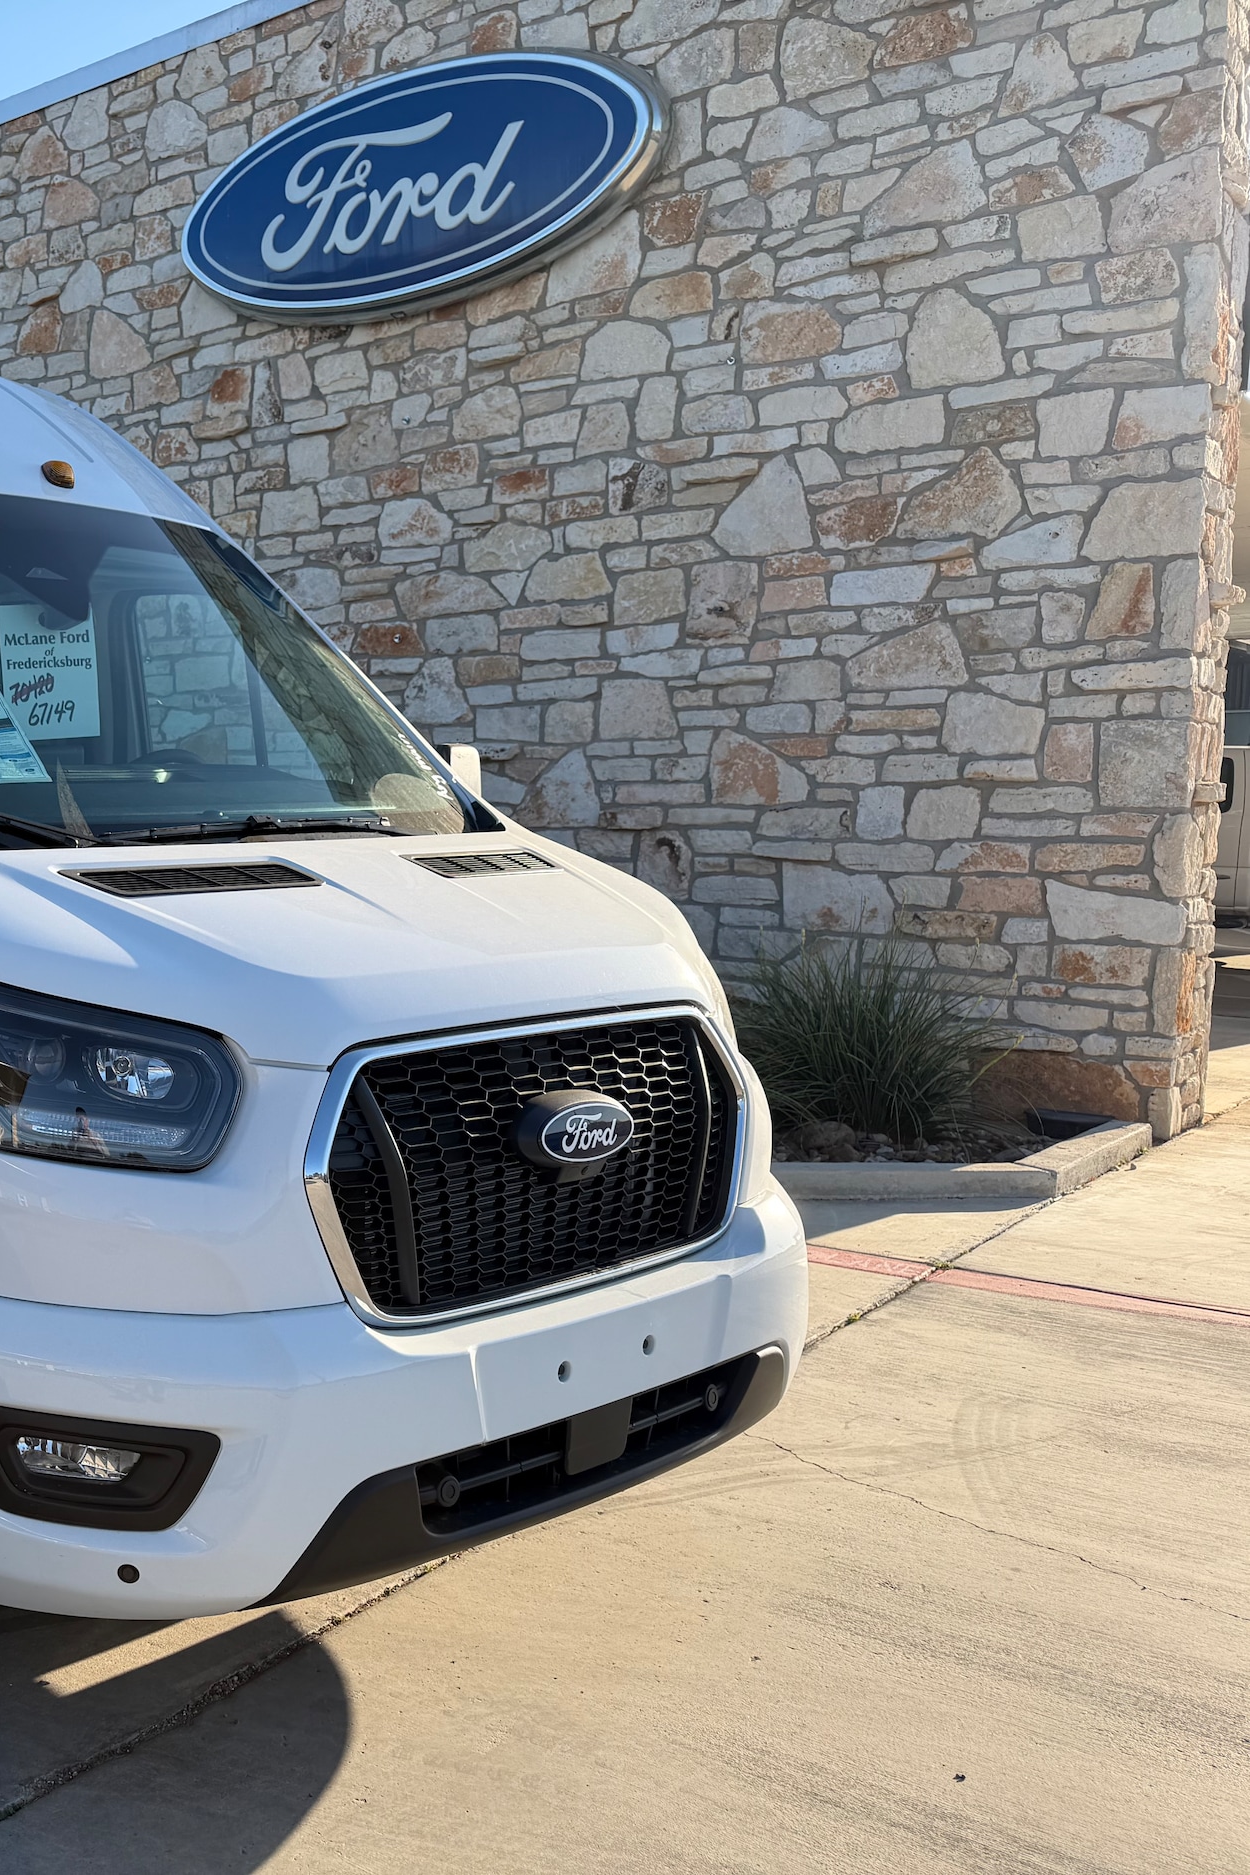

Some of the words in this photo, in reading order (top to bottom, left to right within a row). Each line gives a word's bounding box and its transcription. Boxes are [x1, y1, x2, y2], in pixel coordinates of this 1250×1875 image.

[260, 111, 525, 273] Ford
[4, 632, 56, 647] McLane
[59, 629, 90, 644] Ford
[6, 655, 93, 670] Fredericksburg
[44, 646, 55, 657] of
[28, 699, 76, 727] 67149
[561, 1112, 618, 1154] Ford
